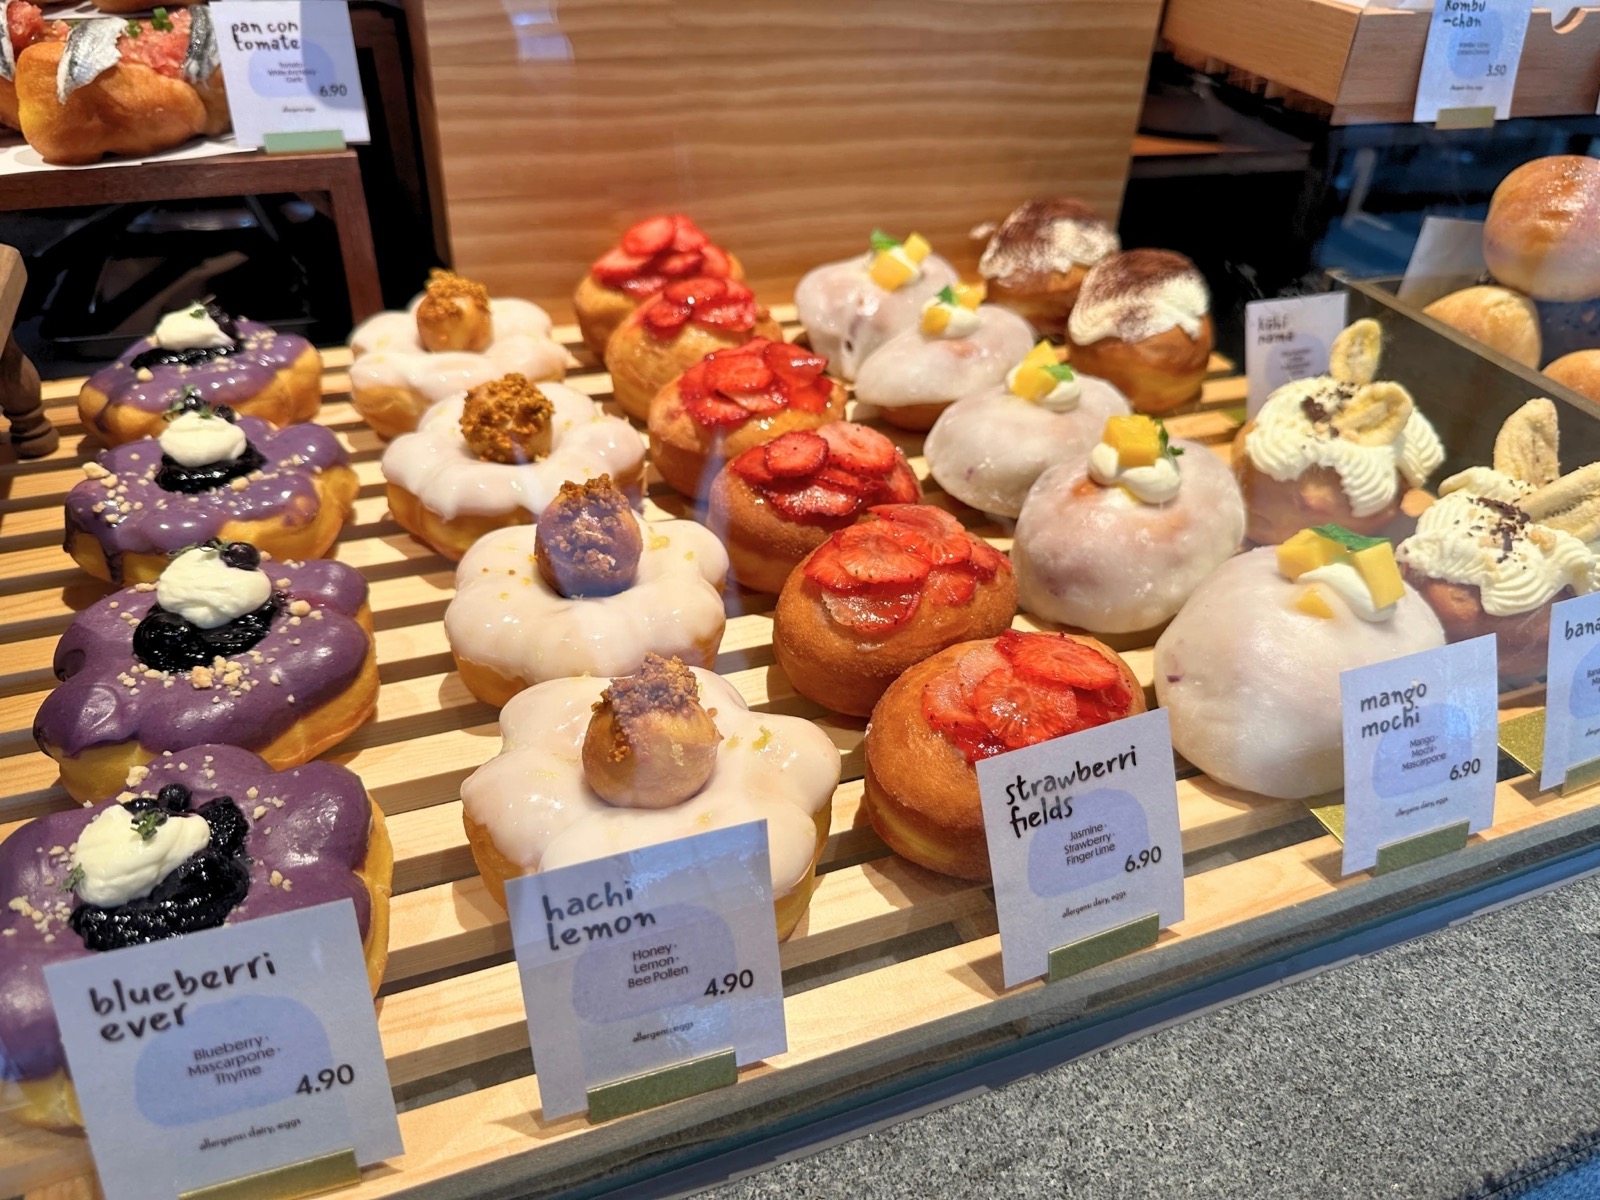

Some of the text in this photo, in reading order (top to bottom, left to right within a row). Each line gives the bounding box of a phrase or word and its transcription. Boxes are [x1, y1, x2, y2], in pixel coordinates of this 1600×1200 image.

[231, 21, 299, 35] pan con
[233, 33, 300, 51] tomate
[319, 84, 348, 97] 6.90
[1360, 682, 1427, 713] mango
[1361, 705, 1420, 738] mochi
[1005, 745, 1137, 805] strawberri
[1401, 752, 1447, 772] Mascarpone
[1449, 758, 1481, 781] 6.90
[1010, 796, 1074, 838] fields
[1066, 843, 1115, 866] Finger Lime
[1124, 846, 1162, 873] 6.90
[542, 880, 634, 921] hachi
[546, 910, 656, 952] lemon
[88, 952, 276, 1017] blueberri
[628, 965, 689, 989] Bee Pollen
[704, 968, 754, 998] 4.90
[99, 1002, 189, 1044] ever
[215, 1065, 263, 1085] Thyme
[295, 1063, 355, 1096] 4.90
